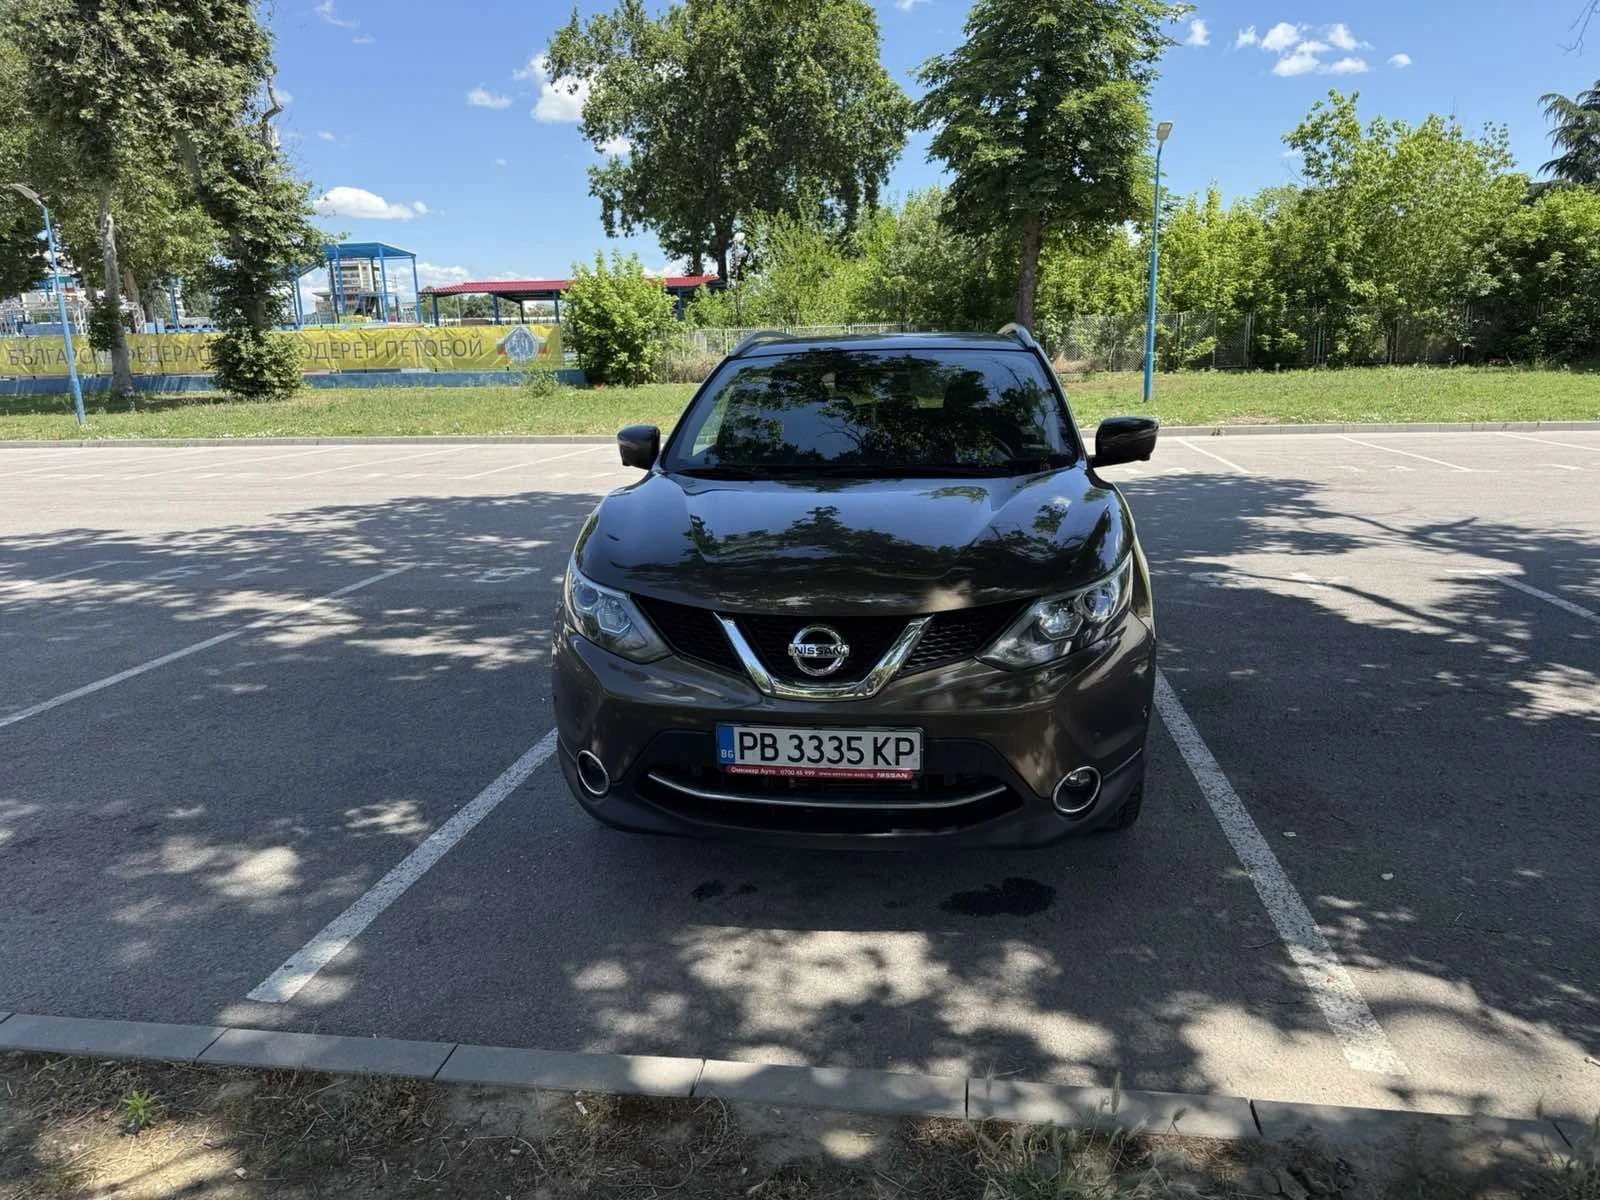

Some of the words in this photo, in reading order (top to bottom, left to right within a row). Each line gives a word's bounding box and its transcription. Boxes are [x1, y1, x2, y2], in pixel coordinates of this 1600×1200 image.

[8, 346, 112, 366] БЪЛГАС
[129, 343, 211, 367] ЕДЕРАЦ
[299, 340, 378, 364] ОДЕРЕН
[385, 334, 483, 359] ПЕТОБОЙ
[794, 644, 842, 656] NISSAN
[720, 749, 734, 759] BG
[738, 731, 779, 762] PB
[786, 734, 865, 765] 3335
[872, 736, 915, 767] KP
[876, 771, 909, 779] NISSAN
